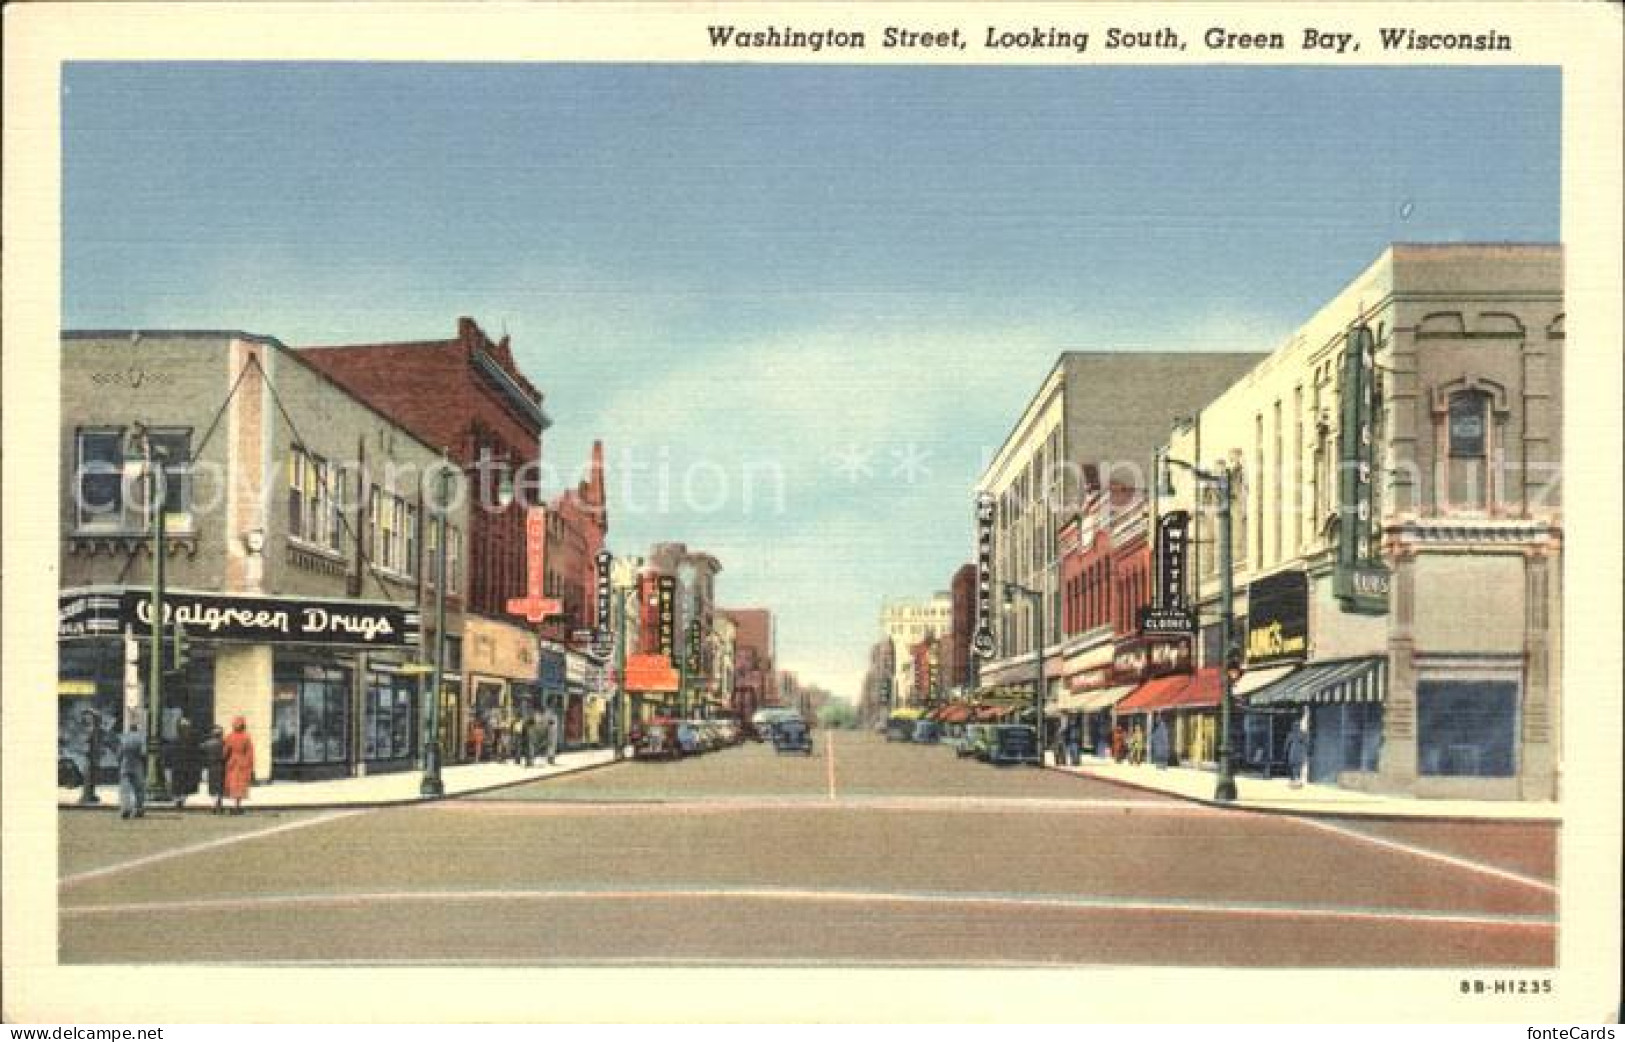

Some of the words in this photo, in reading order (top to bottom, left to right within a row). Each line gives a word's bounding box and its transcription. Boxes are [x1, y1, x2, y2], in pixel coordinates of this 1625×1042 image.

[708, 25, 865, 52] Washington
[883, 26, 967, 50] Street,
[985, 26, 1089, 53] Looking
[1105, 27, 1187, 51] South,
[1204, 27, 1285, 50] Green
[1303, 27, 1359, 53] Bay,
[1380, 27, 1512, 51] Wisconsin
[136, 599, 289, 633] Walgreen
[301, 607, 394, 641] Drugs
